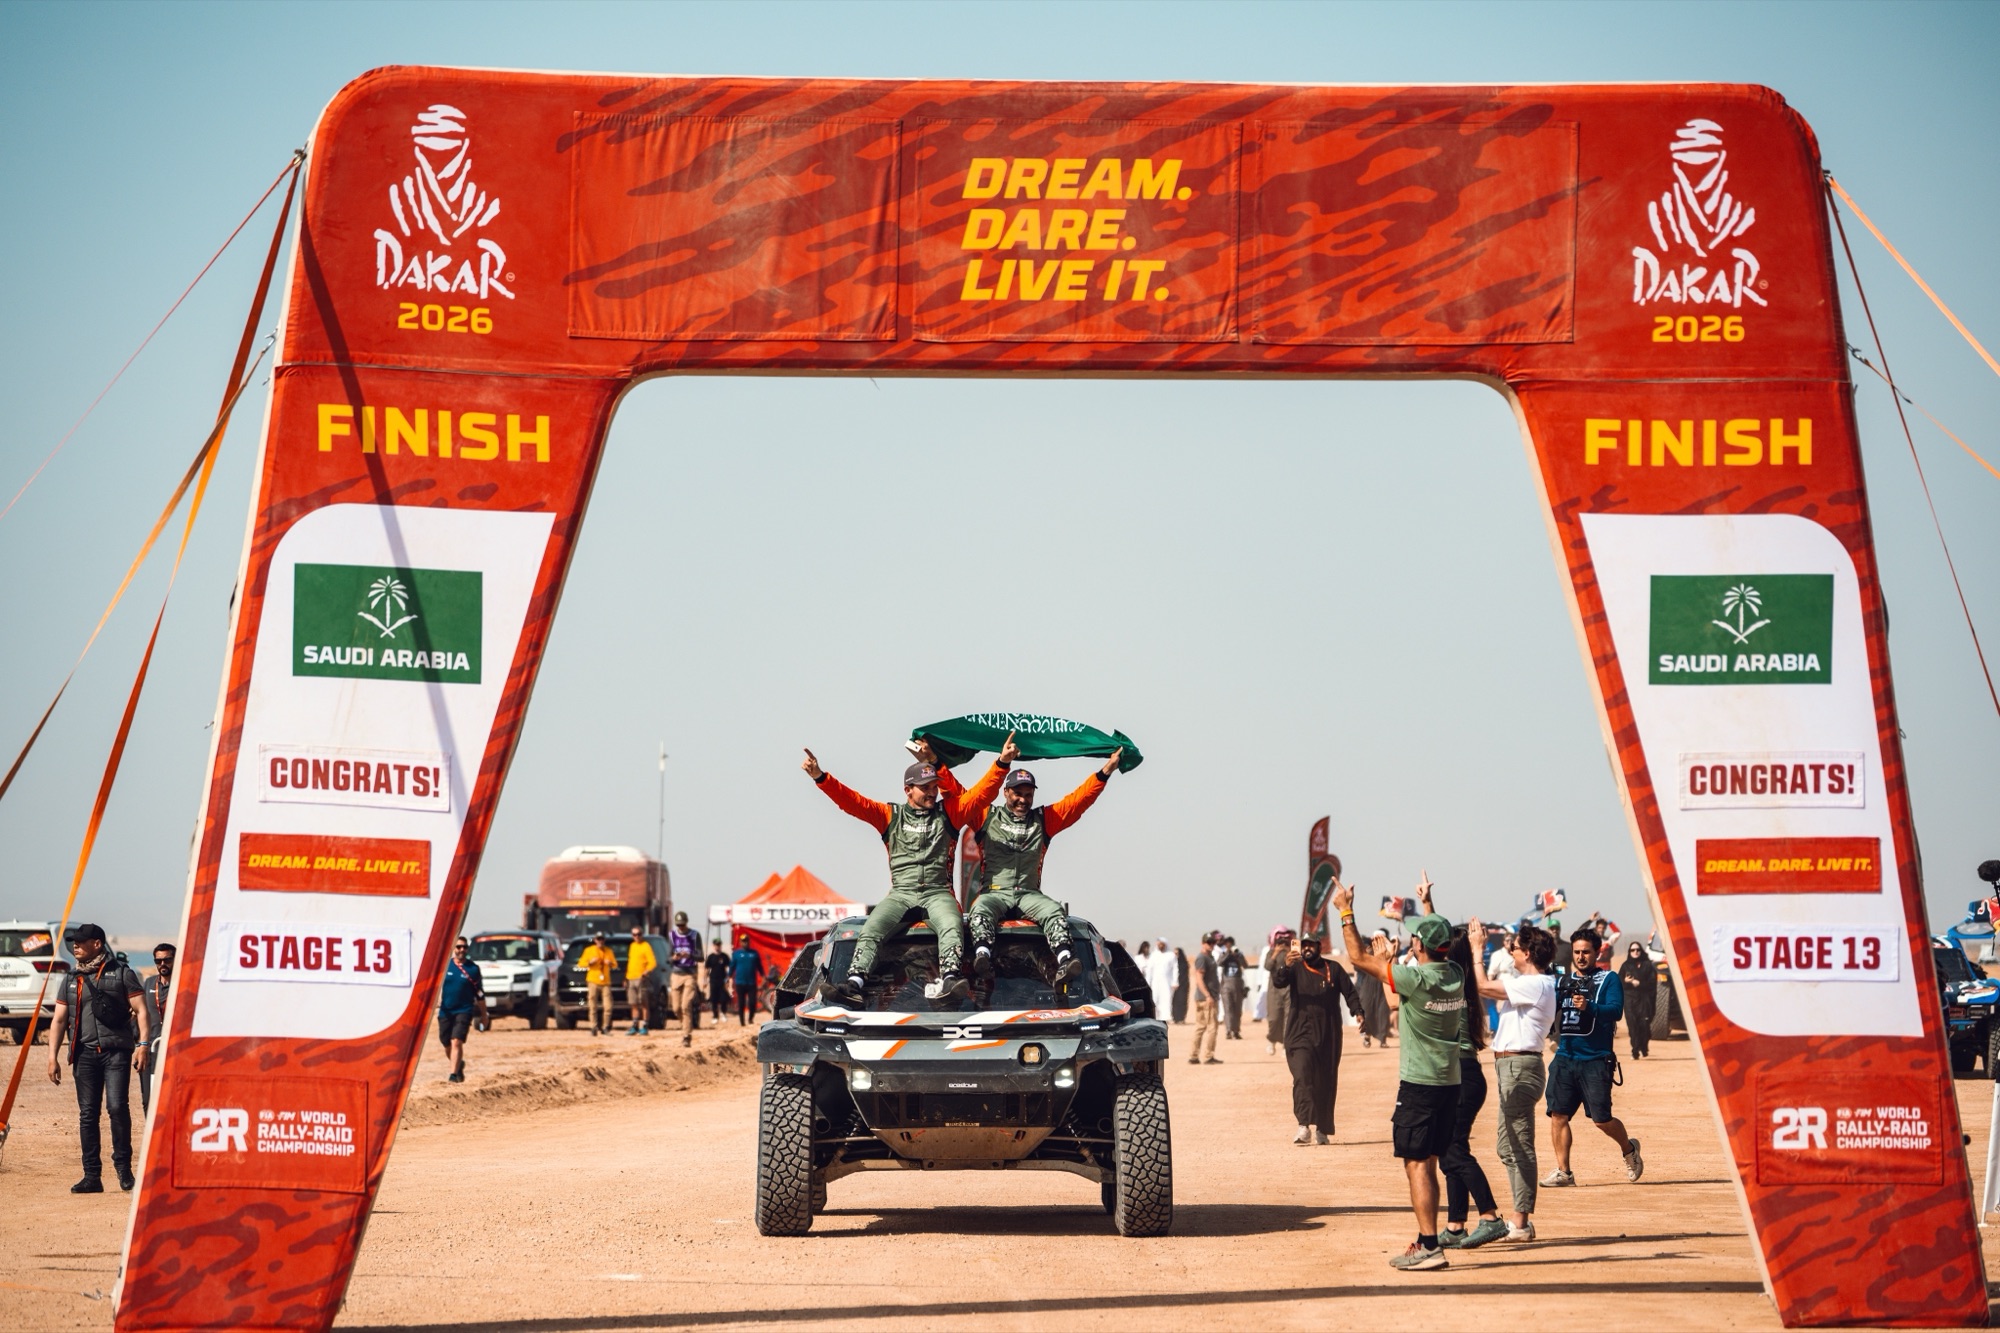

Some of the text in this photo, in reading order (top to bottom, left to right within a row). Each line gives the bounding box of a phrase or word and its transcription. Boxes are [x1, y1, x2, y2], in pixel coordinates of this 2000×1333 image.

[961, 157, 1192, 201] DREAM.
[960, 208, 1137, 251] DARE.
[374, 228, 515, 299] DAKAR
[1632, 246, 1768, 308] DAKAR
[960, 259, 1170, 301] LIVE IT.
[397, 302, 493, 334] 2026
[1652, 315, 1745, 343] 2026
[317, 403, 551, 463] FINISH
[1584, 418, 1813, 467] FINISH
[303, 645, 470, 671] SAUDI ARABIA
[1659, 653, 1821, 673] SAUDI ARABIA
[269, 756, 441, 798] CONGRATS!
[1689, 763, 1855, 796] CONGRATS!
[248, 853, 421, 875] DREAM. DARE. LIVE IT.
[1705, 857, 1872, 873] DREAM. DARE. LIVE IT.
[767, 908, 830, 920] TUDOR
[239, 934, 392, 974] STAGE 13
[1733, 936, 1881, 970] STAGE 13
[1562, 1010, 1580, 1025] 15
[300, 1110, 347, 1126] WORLD
[1772, 1106, 1828, 1150] 2R
[1836, 1120, 1929, 1136] RALLY-RAID
[1876, 1106, 1921, 1120] WORLD
[191, 1108, 249, 1152] 2R
[257, 1123, 353, 1143] RALLY-RAID
[1836, 1136, 1932, 1150] CHAMPIONSHIP
[257, 1140, 355, 1157] CHAMPIONSHIP
